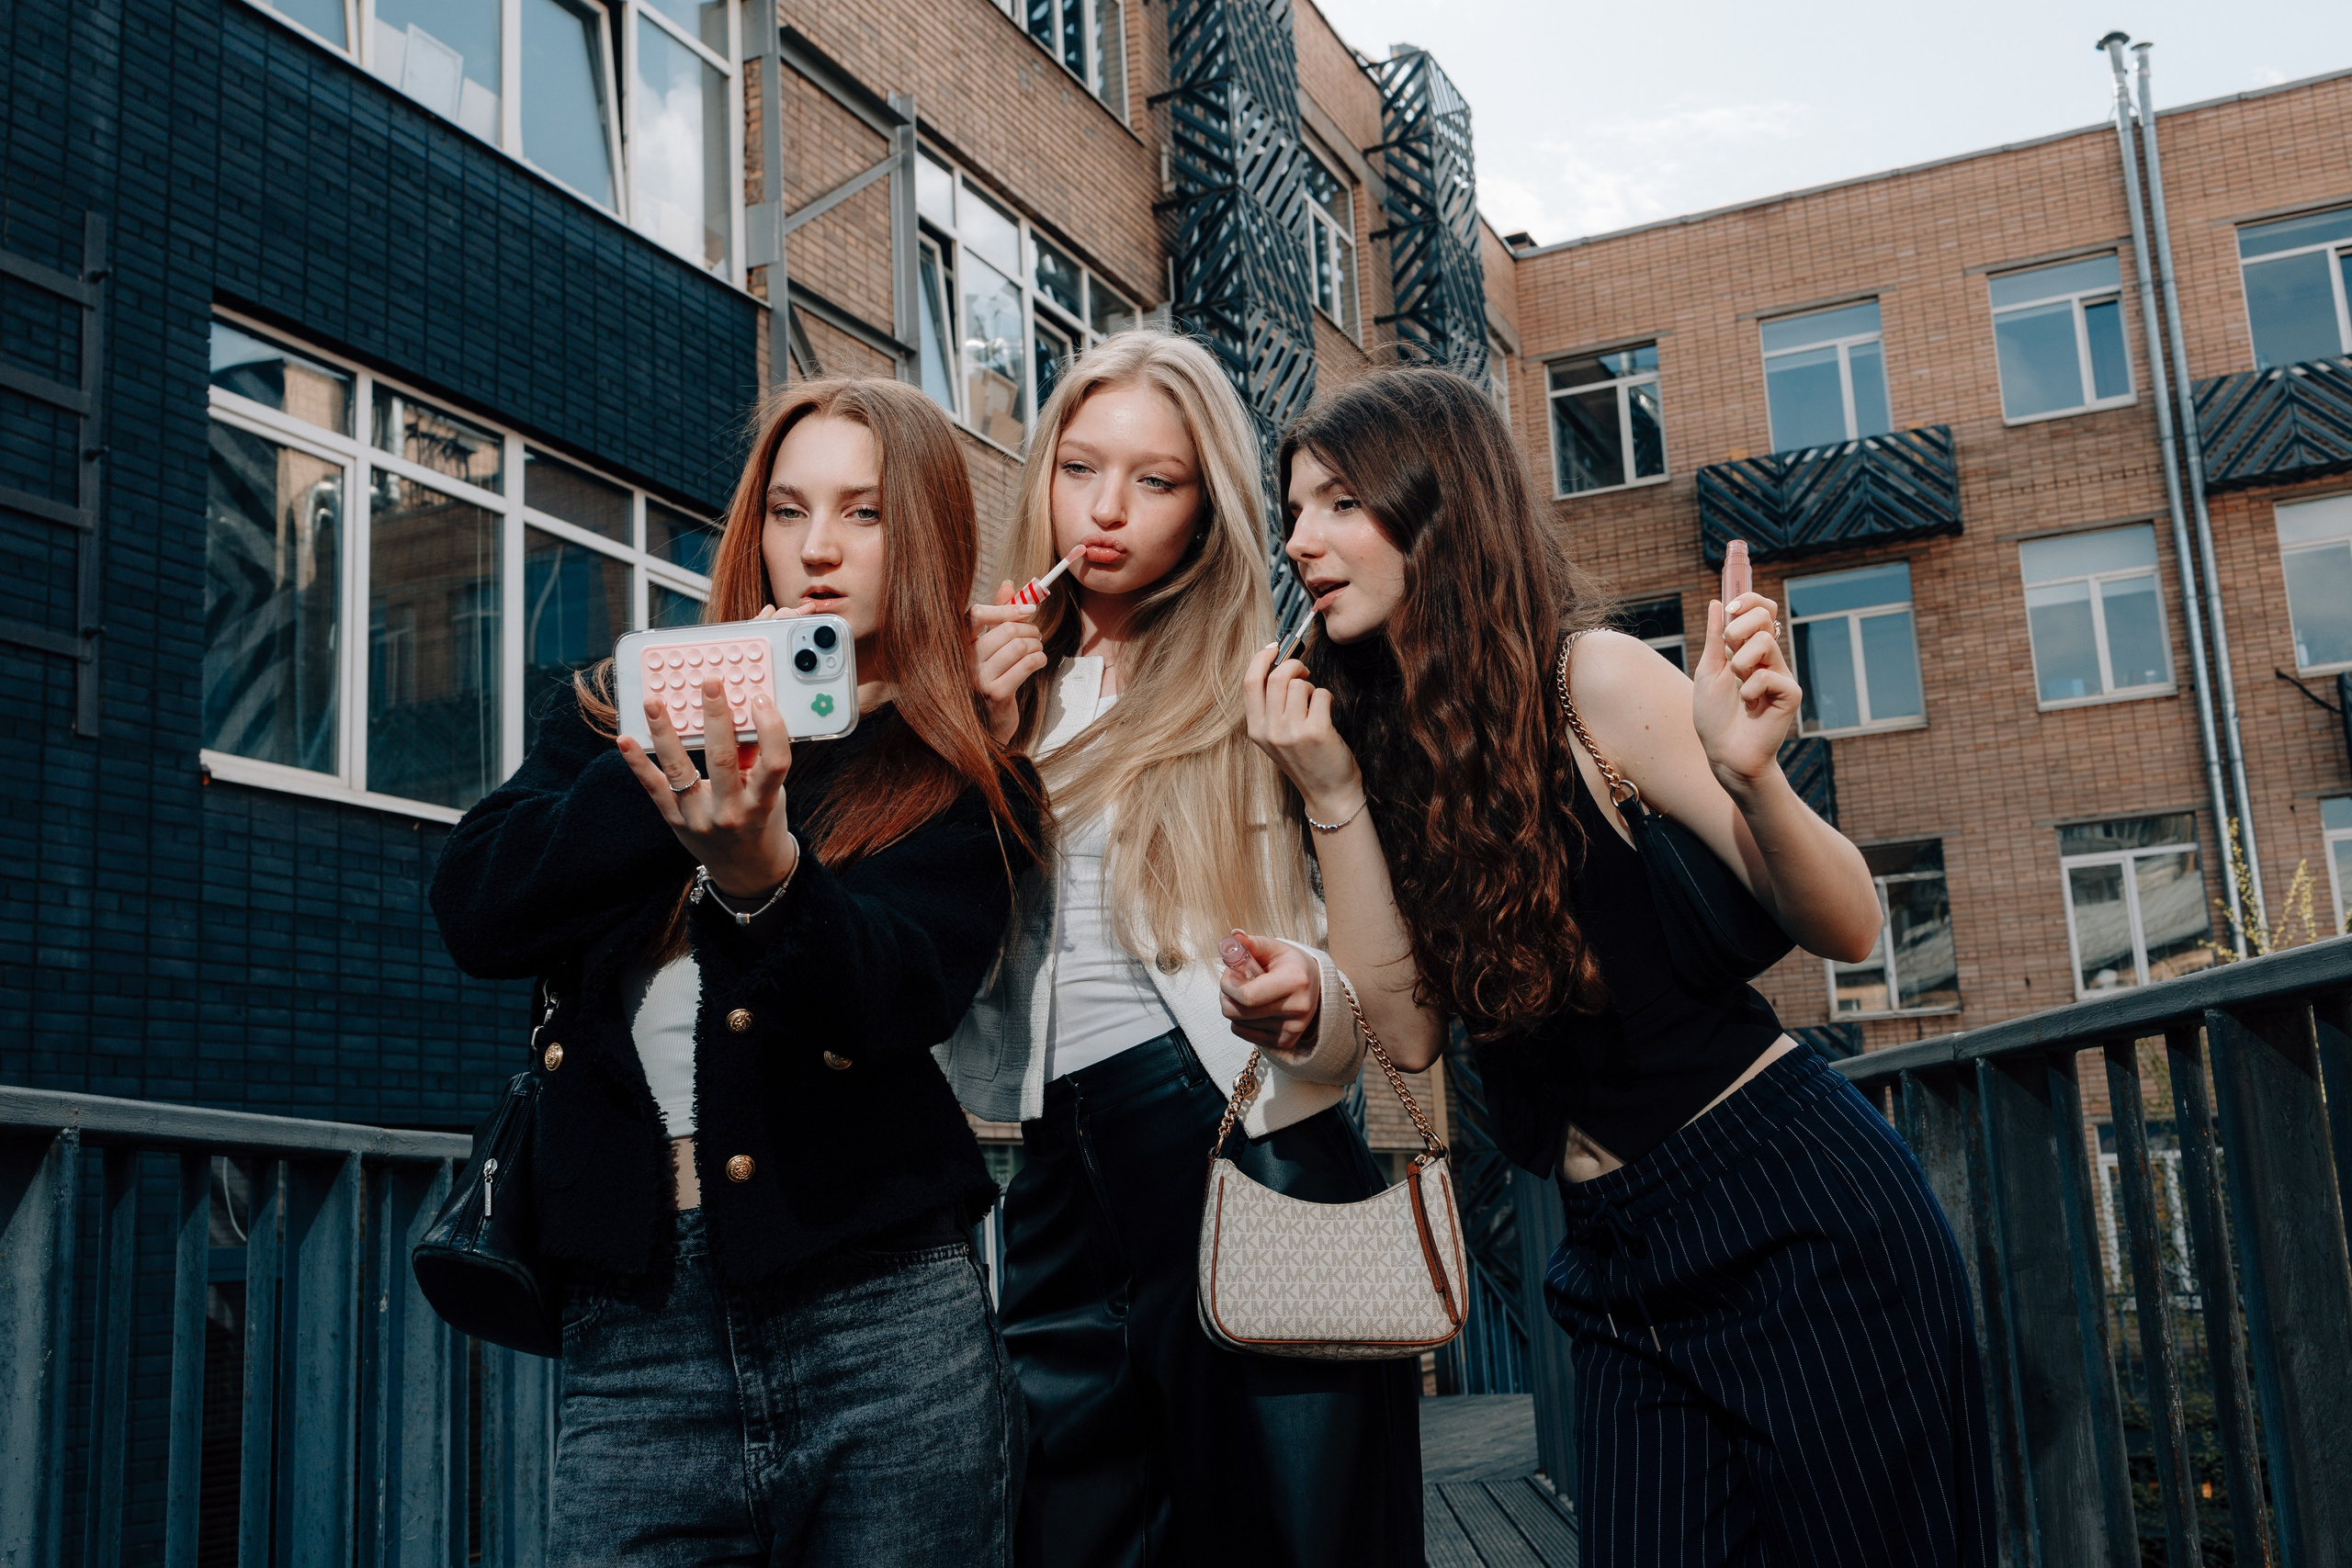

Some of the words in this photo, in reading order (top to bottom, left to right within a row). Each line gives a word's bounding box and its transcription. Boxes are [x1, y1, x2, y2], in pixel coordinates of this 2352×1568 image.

[1250, 1187, 1277, 1202] MK
[1233, 1202, 1261, 1219] MK
[1262, 1202, 1290, 1219] MK
[1291, 1202, 1319, 1219] MK
[1320, 1205, 1348, 1220] MK
[1350, 1205, 1376, 1220] MK
[1378, 1205, 1407, 1220] MK
[1246, 1218, 1273, 1235] MK
[1275, 1218, 1303, 1235] MK
[1305, 1218, 1333, 1235] MK
[1334, 1221, 1363, 1235] MK
[1363, 1221, 1393, 1235] MK
[1229, 1234, 1258, 1250] MK
[1259, 1234, 1288, 1250] MK
[1289, 1234, 1317, 1250] MK
[1318, 1236, 1346, 1251] MK
[1348, 1236, 1376, 1251] MK
[1377, 1236, 1407, 1251] MK
[1242, 1250, 1272, 1266] MK
[1272, 1250, 1301, 1266] MK
[1303, 1250, 1331, 1266] MK
[1332, 1252, 1362, 1268] MK
[1362, 1252, 1389, 1268] MK
[1390, 1252, 1419, 1268] MK
[1226, 1267, 1254, 1282] MK
[1255, 1267, 1283, 1282] MK
[1285, 1267, 1314, 1282] MK
[1316, 1268, 1344, 1283] MK
[1345, 1268, 1374, 1283] MK
[1375, 1268, 1404, 1283] MK
[1405, 1268, 1431, 1283] MK
[1238, 1283, 1266, 1300] MK
[1269, 1283, 1297, 1300] MK
[1299, 1283, 1328, 1300] MK
[1329, 1284, 1358, 1300] MK
[1359, 1284, 1387, 1300] MK
[1389, 1284, 1418, 1300] MK
[1221, 1301, 1250, 1316] MK
[1251, 1301, 1281, 1316] MK
[1282, 1301, 1311, 1316] MK
[1312, 1301, 1341, 1316] MK
[1342, 1301, 1372, 1317] MK
[1373, 1301, 1401, 1317] MK
[1403, 1301, 1431, 1317] MK
[1235, 1317, 1264, 1334] MK
[1265, 1317, 1294, 1334] MK
[1295, 1317, 1325, 1334] MK
[1326, 1318, 1354, 1336] MK
[1356, 1318, 1385, 1336] MK
[1386, 1318, 1414, 1336] MK
[1416, 1318, 1444, 1336] MK
